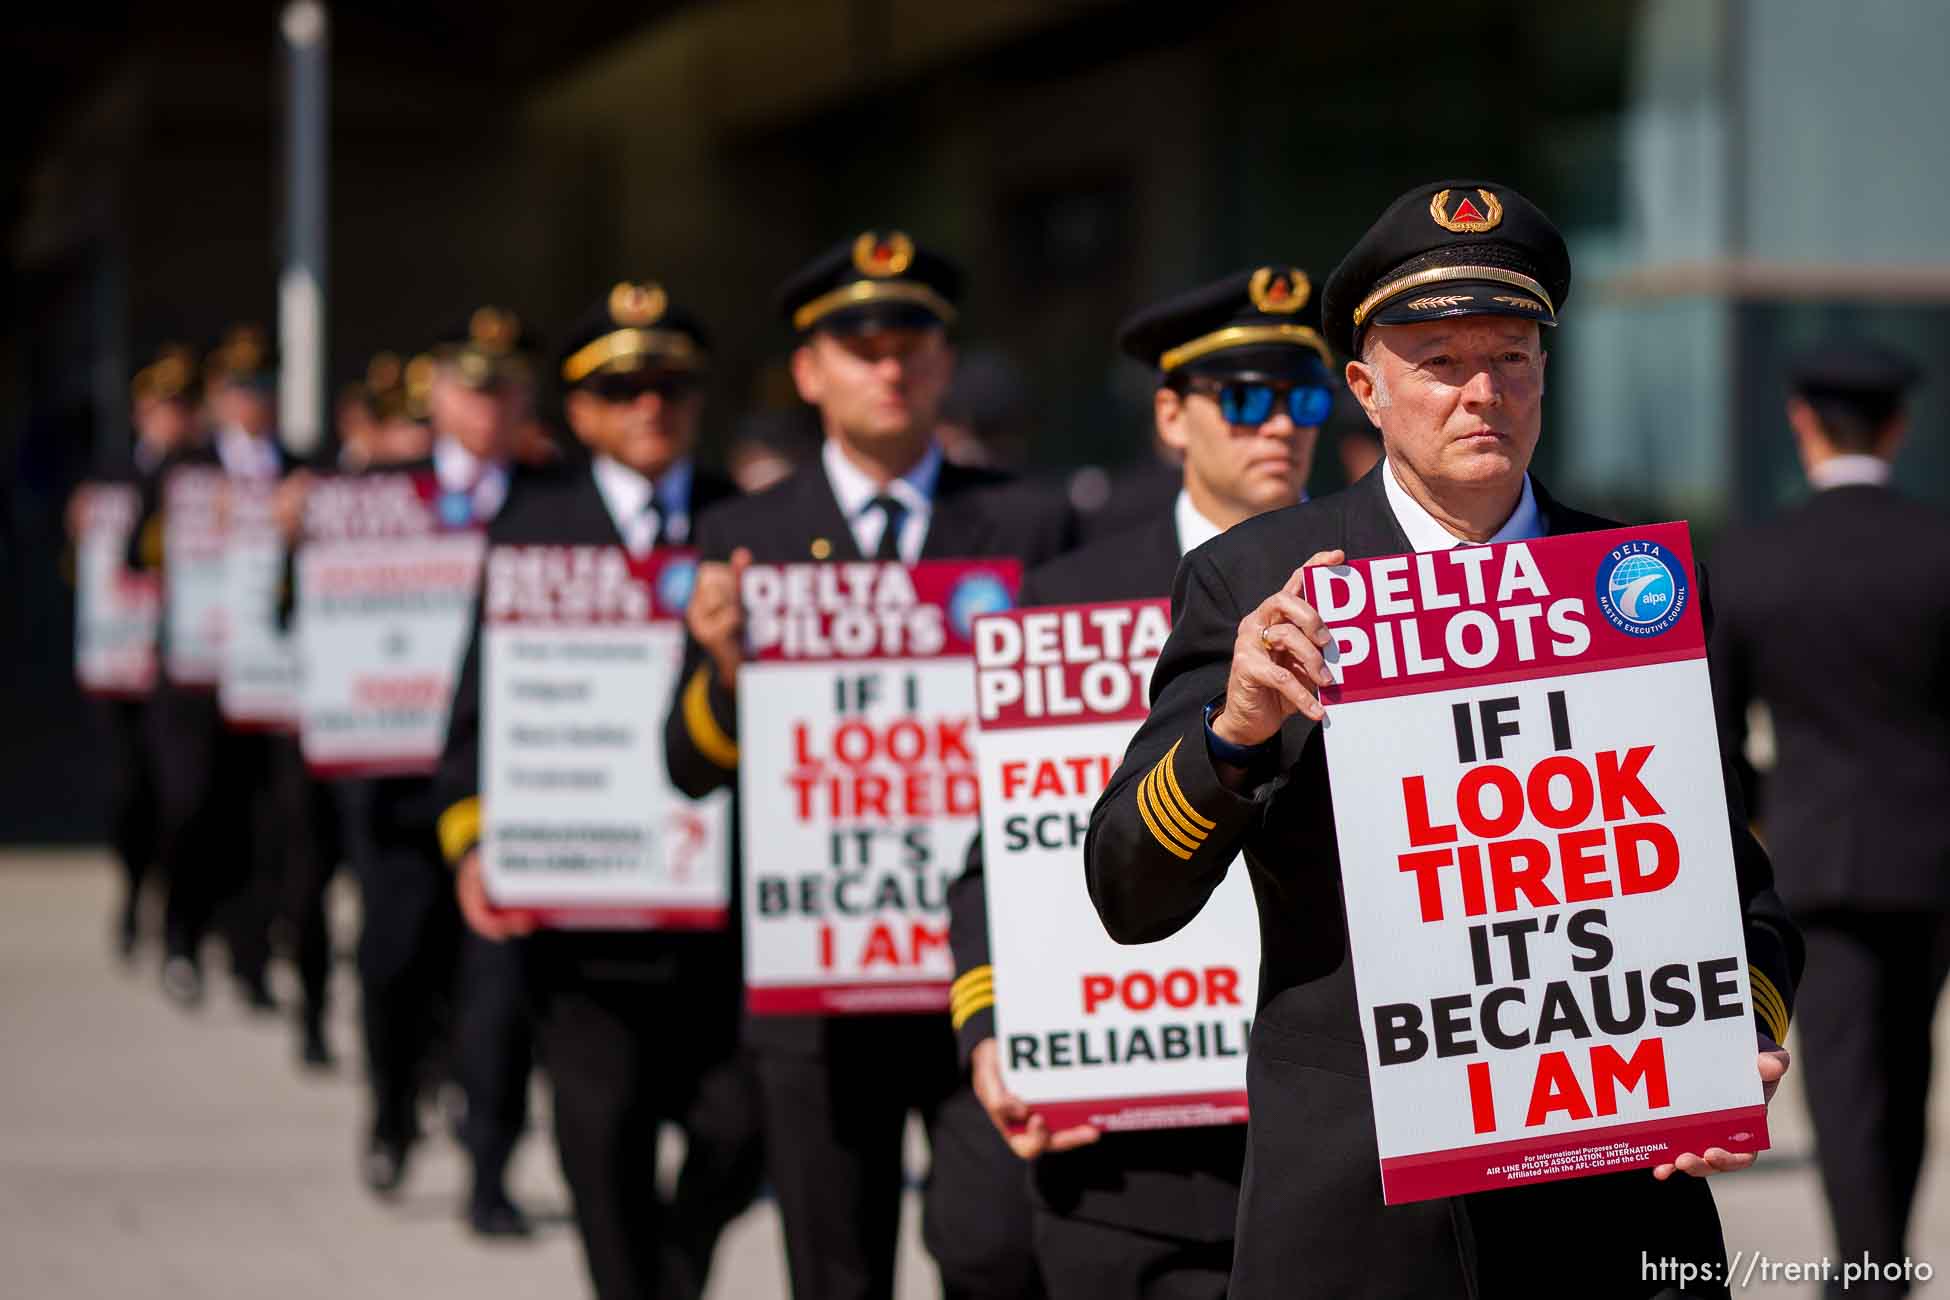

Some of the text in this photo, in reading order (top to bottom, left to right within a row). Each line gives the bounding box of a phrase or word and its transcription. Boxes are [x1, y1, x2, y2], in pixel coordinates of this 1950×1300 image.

[1612, 543, 1660, 561] DELTA
[741, 561, 918, 610] DELTA
[1311, 543, 1550, 623] DELTA
[1642, 592, 1667, 606] alpa
[750, 603, 946, 656] PILOTS
[1600, 586, 1685, 635] MASTER EXECUTIVE COUNCIL
[974, 605, 1172, 667] DELTA
[1323, 598, 1592, 684] PILOTS
[836, 674, 918, 713] IF I
[979, 661, 1156, 719] PILOT
[794, 718, 973, 767] LOOK
[1452, 690, 1573, 763] IF I
[786, 766, 980, 821] TIRED
[1001, 755, 1118, 799] FATI
[1402, 745, 1665, 847] LOOK
[757, 871, 951, 917] BECAU
[1397, 822, 1681, 923] TIRED
[819, 923, 834, 969] I
[1468, 909, 1614, 986] IT'S
[1081, 966, 1241, 1015] POOR
[1373, 956, 1745, 1067] BECAUSE
[1467, 1037, 1671, 1135] I AM
[1487, 1143, 1669, 1175] AIR LINE PILOTS ASSOCIATION, INTERNATIONAL
[1507, 1153, 1650, 1180] Affiliated with the AFL-CIO and the CLC
[1524, 1142, 1630, 1163] For Informational Purposes Only
